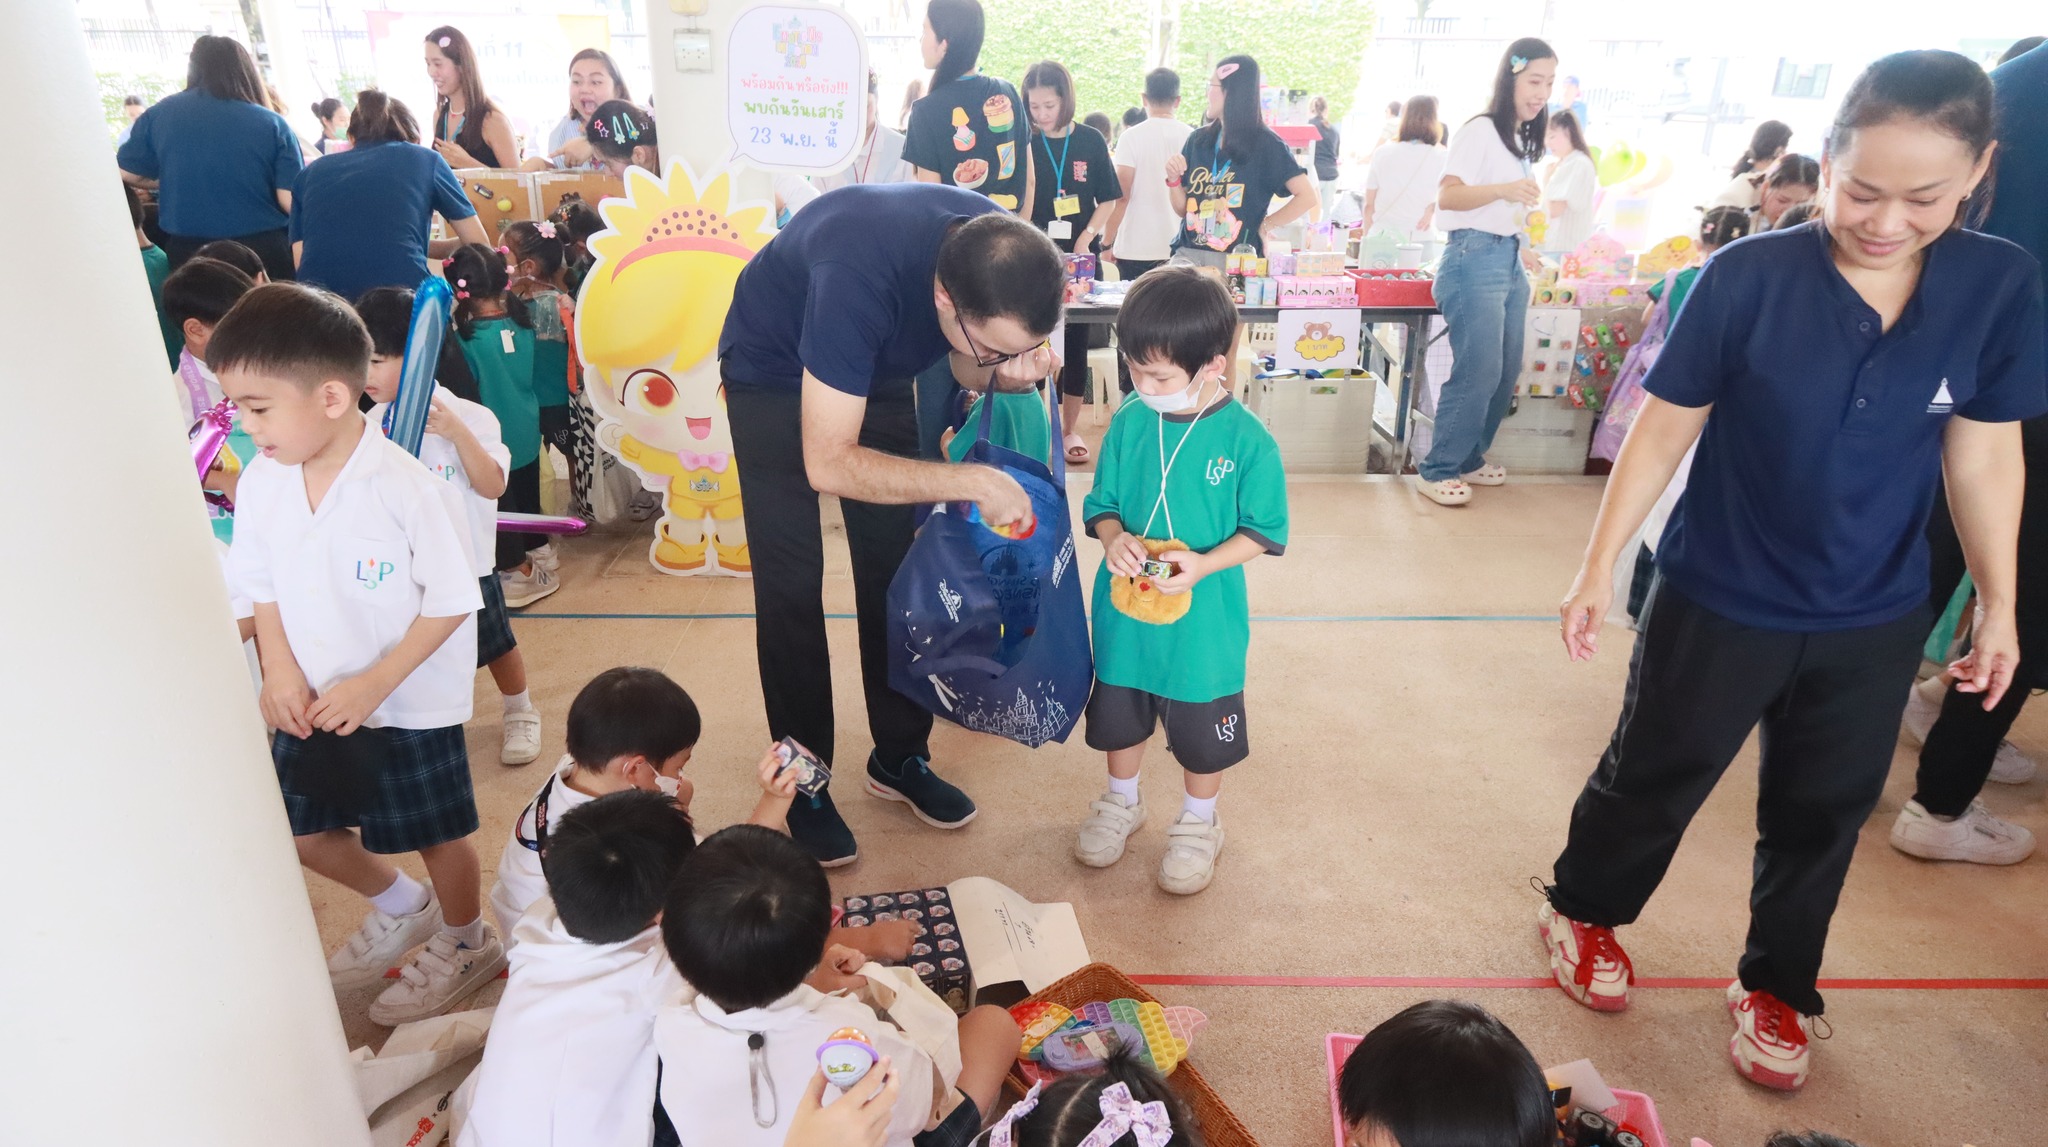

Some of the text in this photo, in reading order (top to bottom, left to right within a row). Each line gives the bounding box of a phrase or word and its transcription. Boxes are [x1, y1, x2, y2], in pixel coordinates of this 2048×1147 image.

[744, 97, 845, 119] พบกันวันเสาร์
[750, 121, 838, 148] 23 พ.ย. นี้
[1206, 459, 1235, 485] LSP
[357, 560, 395, 590] LSP
[1215, 714, 1238, 742] LSP
